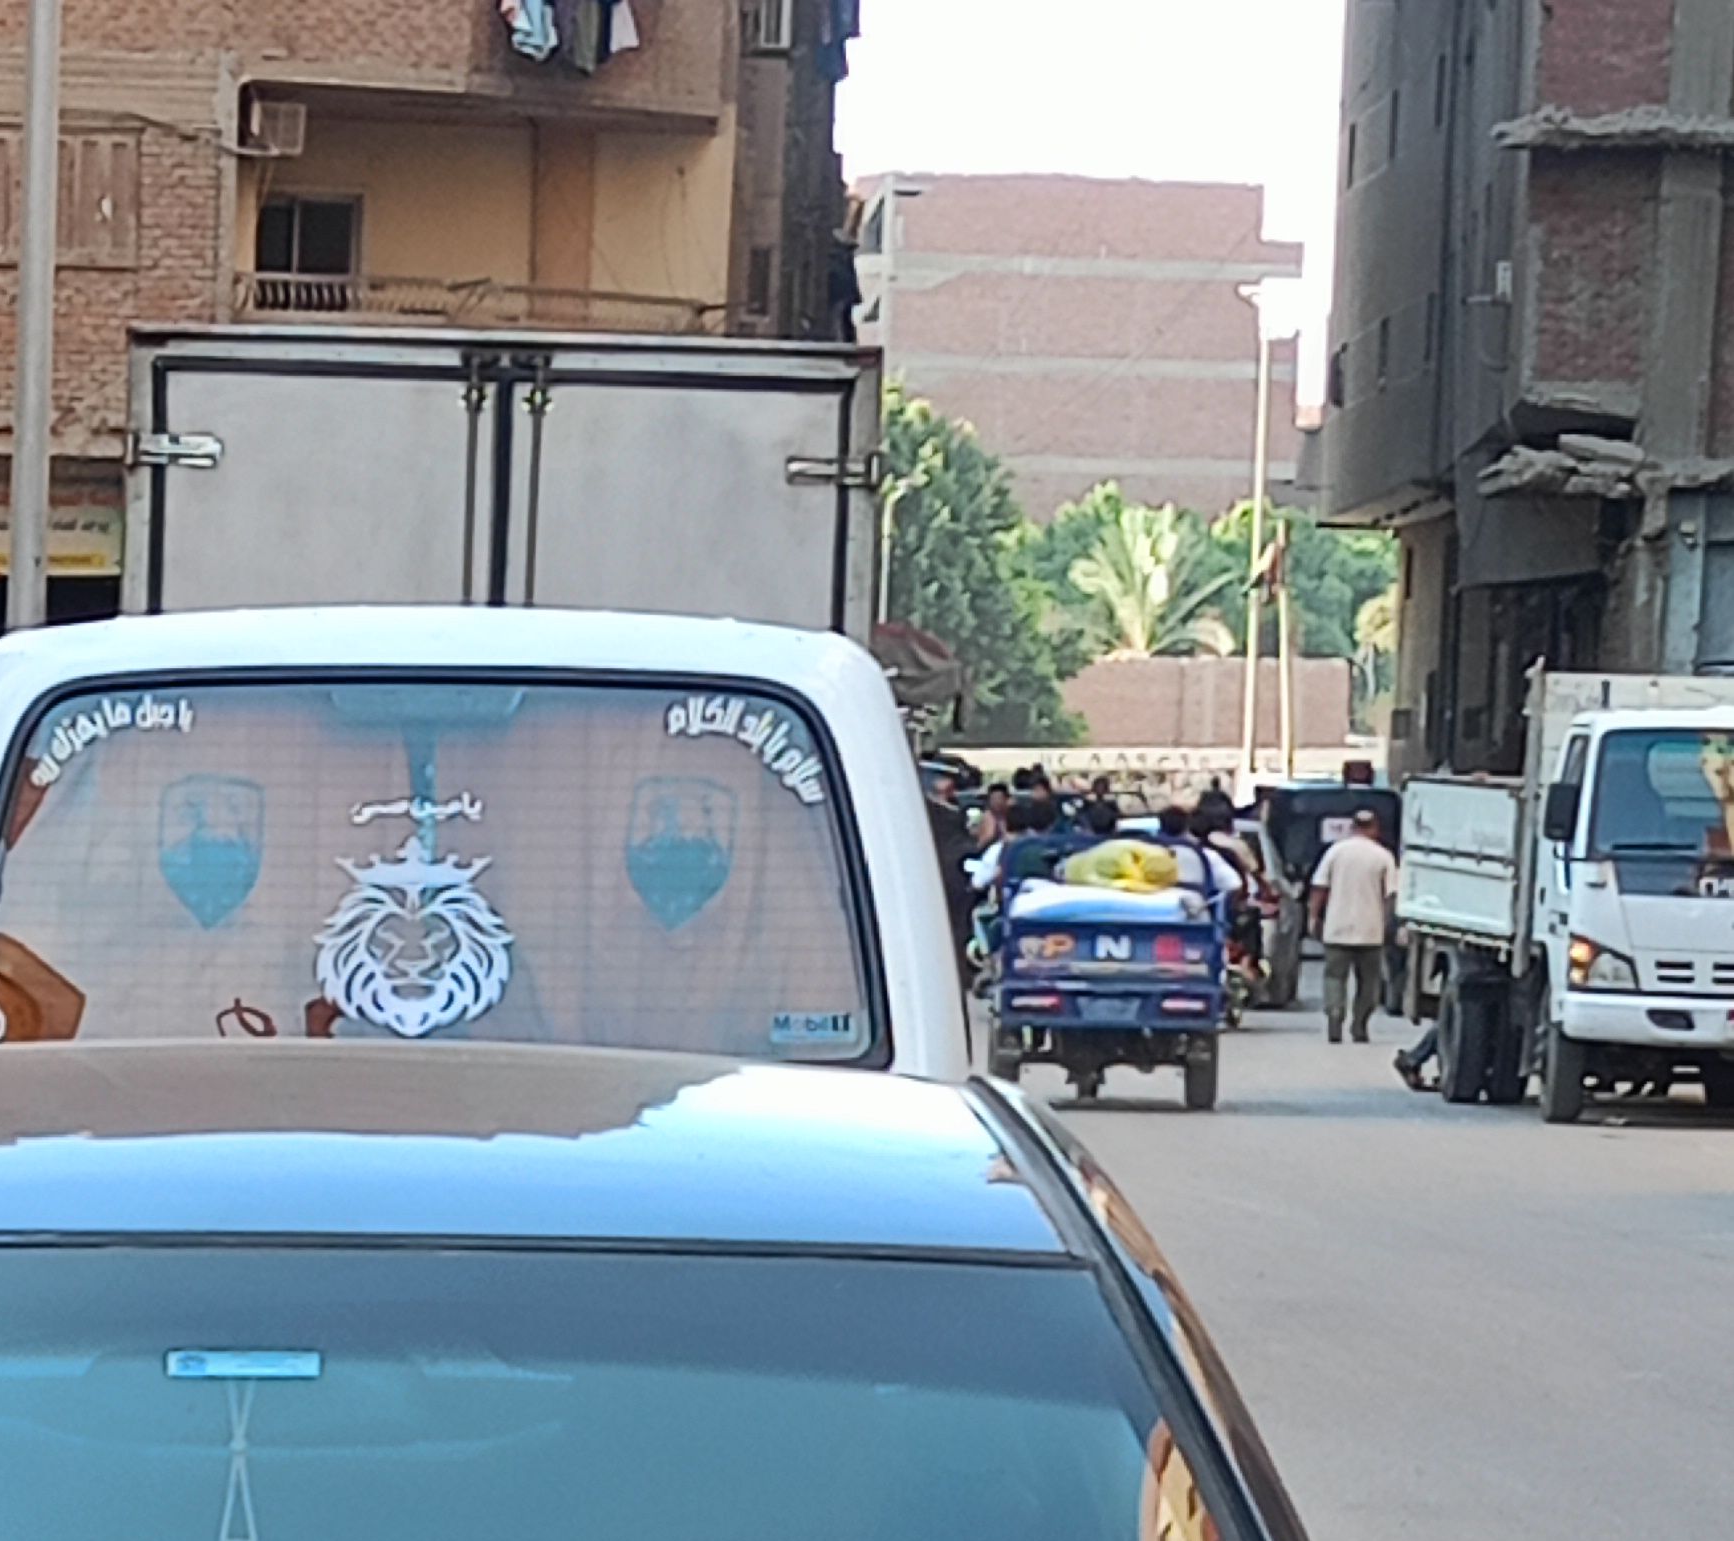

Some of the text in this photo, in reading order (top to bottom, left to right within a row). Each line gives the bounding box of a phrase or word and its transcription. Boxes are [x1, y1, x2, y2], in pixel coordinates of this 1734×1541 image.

[102, 697, 131, 728] ما
[135, 694, 175, 728] جبل
[668, 695, 746, 737] الكلام
[763, 720, 789, 764] يا
[772, 748, 825, 803] سلام
